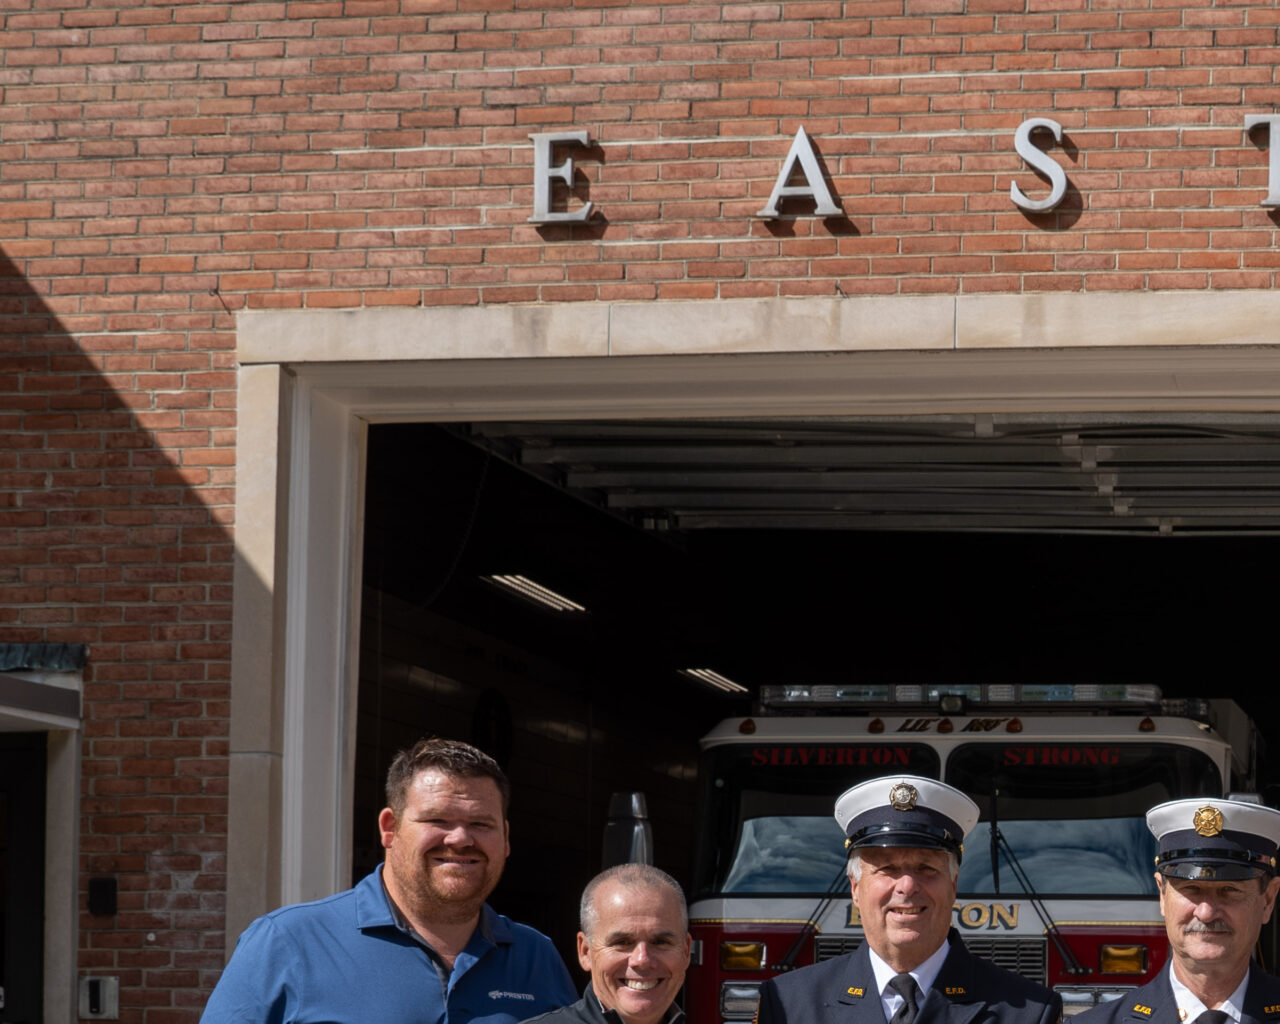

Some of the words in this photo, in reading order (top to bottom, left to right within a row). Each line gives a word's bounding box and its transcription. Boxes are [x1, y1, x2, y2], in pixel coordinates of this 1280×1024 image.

[751, 747, 912, 766] SILVERTON
[1003, 747, 1120, 766] STRONG
[945, 987, 965, 995] E.F.D.
